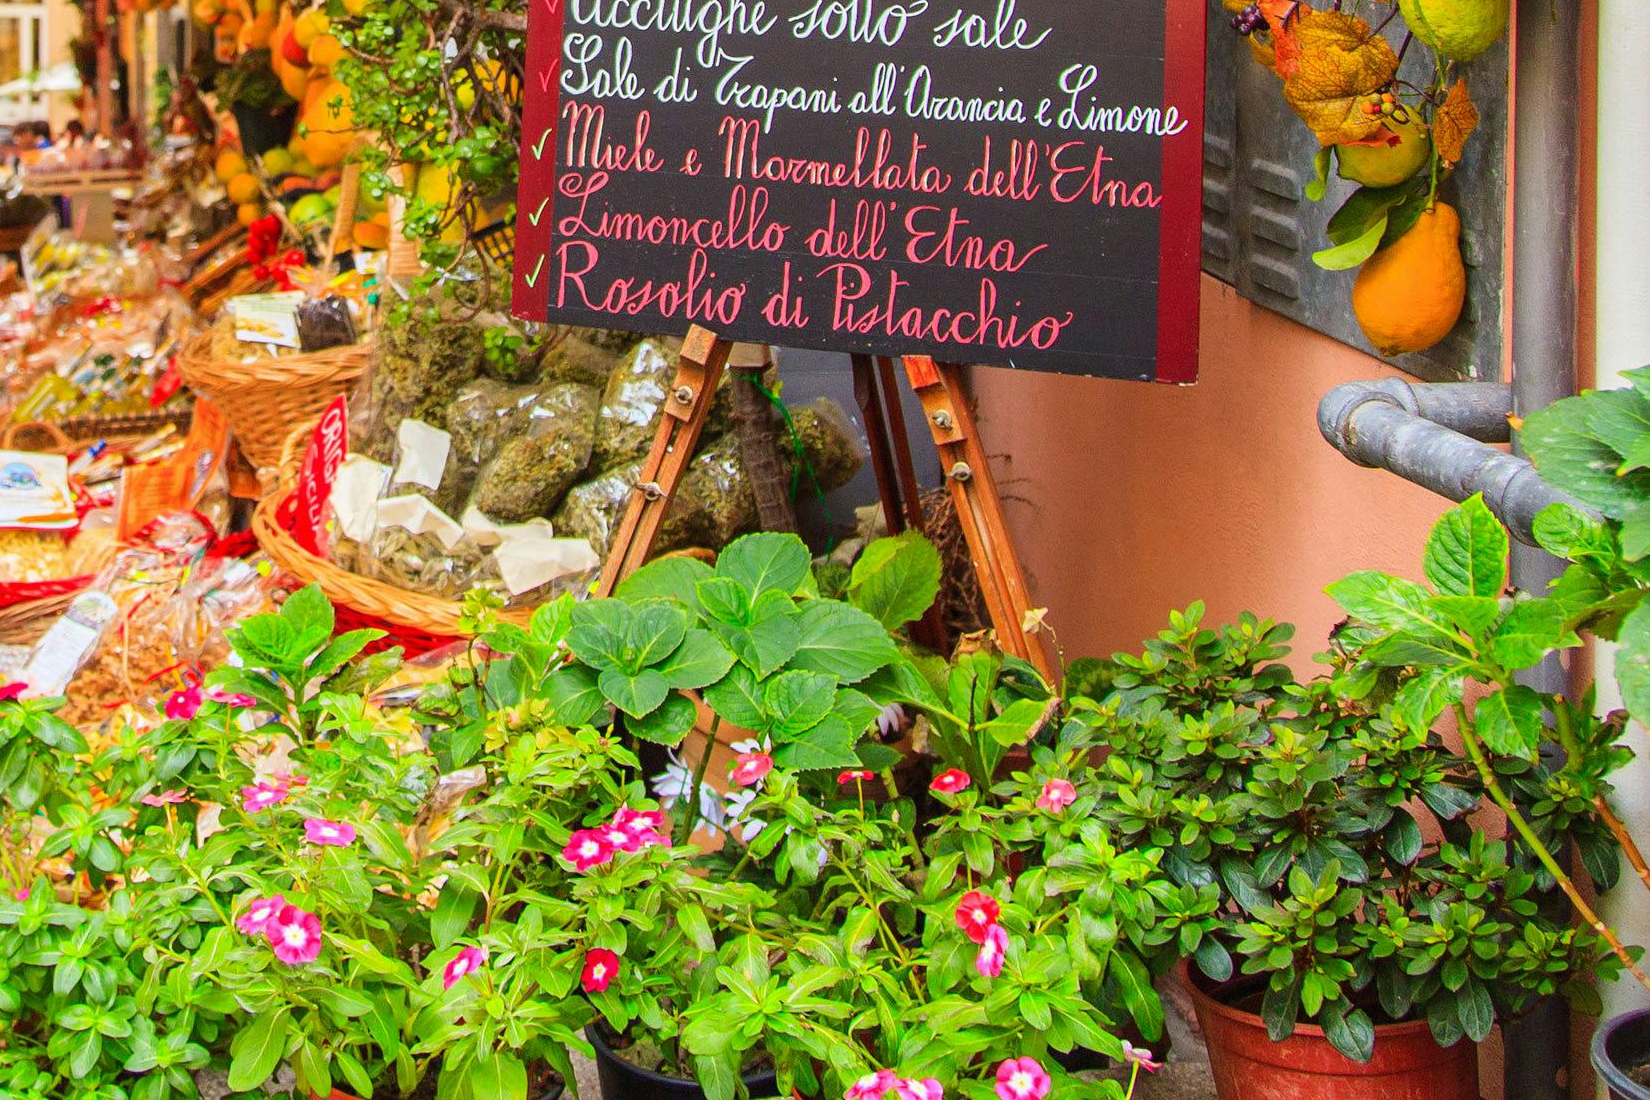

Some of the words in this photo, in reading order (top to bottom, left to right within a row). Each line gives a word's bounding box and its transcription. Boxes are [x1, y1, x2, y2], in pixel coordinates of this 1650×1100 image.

[559, 32, 646, 100] Sale
[652, 47, 698, 103] di
[714, 46, 842, 134] Trapani
[1034, 97, 1053, 127] e
[1057, 63, 1191, 136] Limone
[562, 99, 664, 172] Miele
[679, 148, 703, 176] e
[718, 115, 952, 194] Marmellata
[557, 171, 791, 252] Limoncello
[555, 240, 747, 325] Rosolio
[761, 261, 809, 328] di
[816, 262, 1074, 350] Pistacchio
